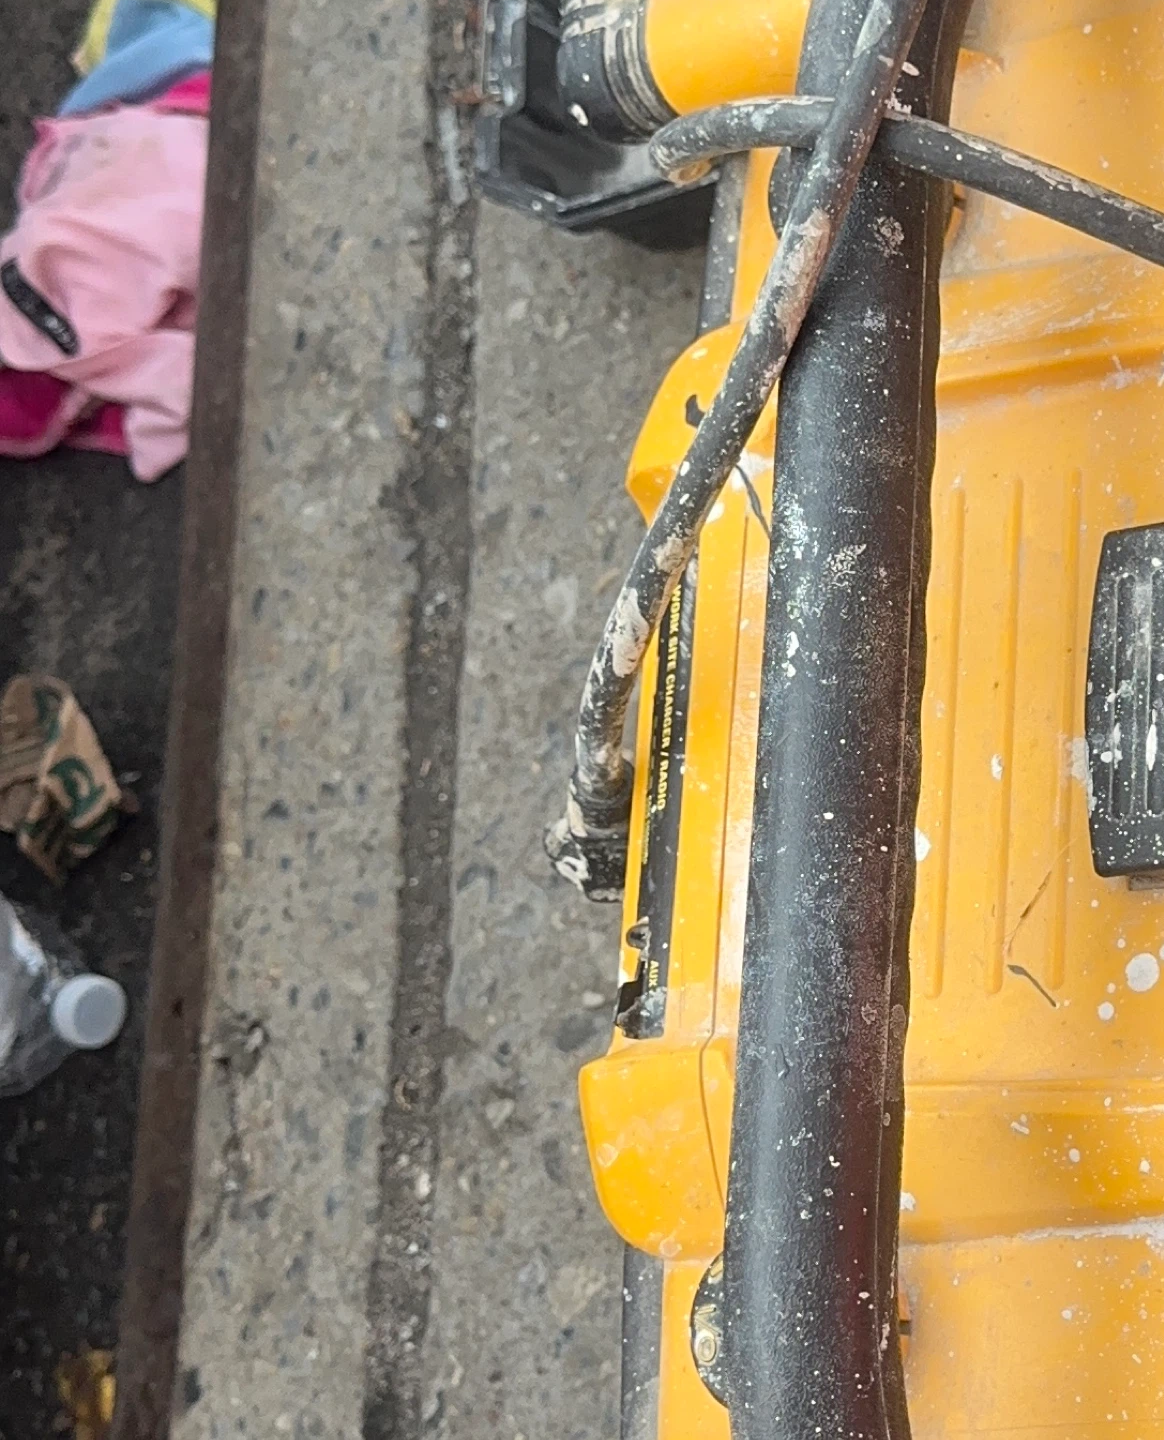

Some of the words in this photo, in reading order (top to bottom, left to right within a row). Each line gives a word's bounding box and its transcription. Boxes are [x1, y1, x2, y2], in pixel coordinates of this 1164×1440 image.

[669, 585, 682, 635] WORK
[666, 637, 679, 671] SITE
[661, 673, 677, 748] CHARGER
[656, 760, 669, 811] RADIO
[648, 960, 660, 988] AUX
